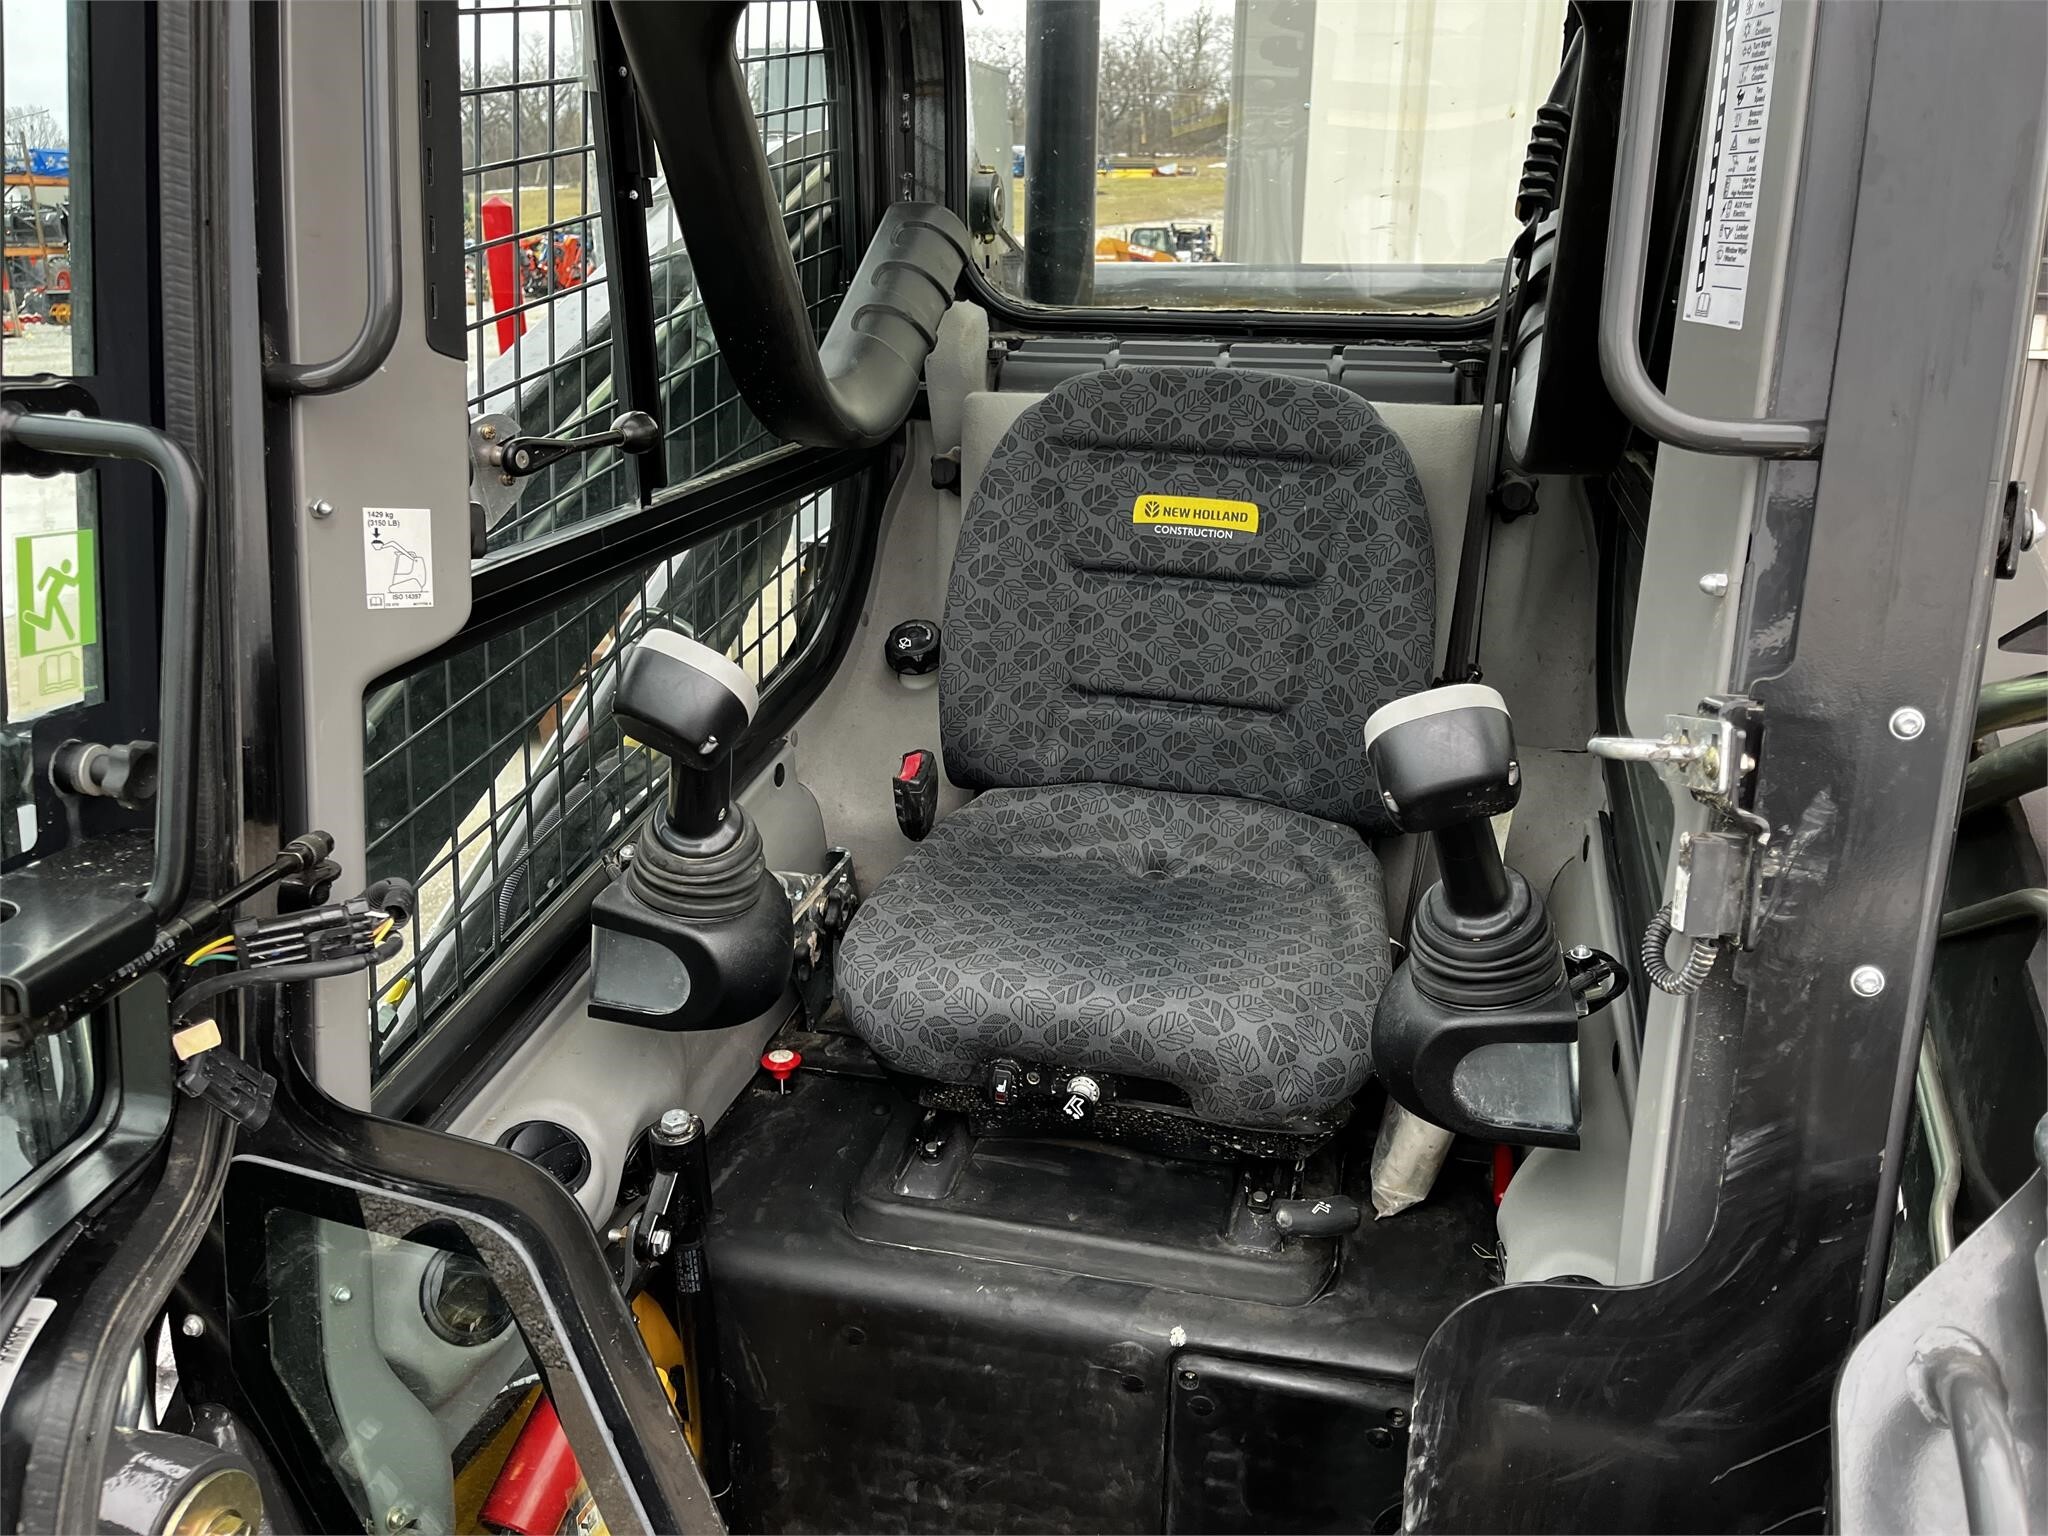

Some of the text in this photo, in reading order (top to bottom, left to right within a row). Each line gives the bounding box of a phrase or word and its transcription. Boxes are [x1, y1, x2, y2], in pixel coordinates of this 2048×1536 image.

[1163, 506, 1248, 523] NEW HOLLAND
[368, 519, 400, 528] (3150 LB)
[1154, 525, 1233, 540] CONSTRUCTION
